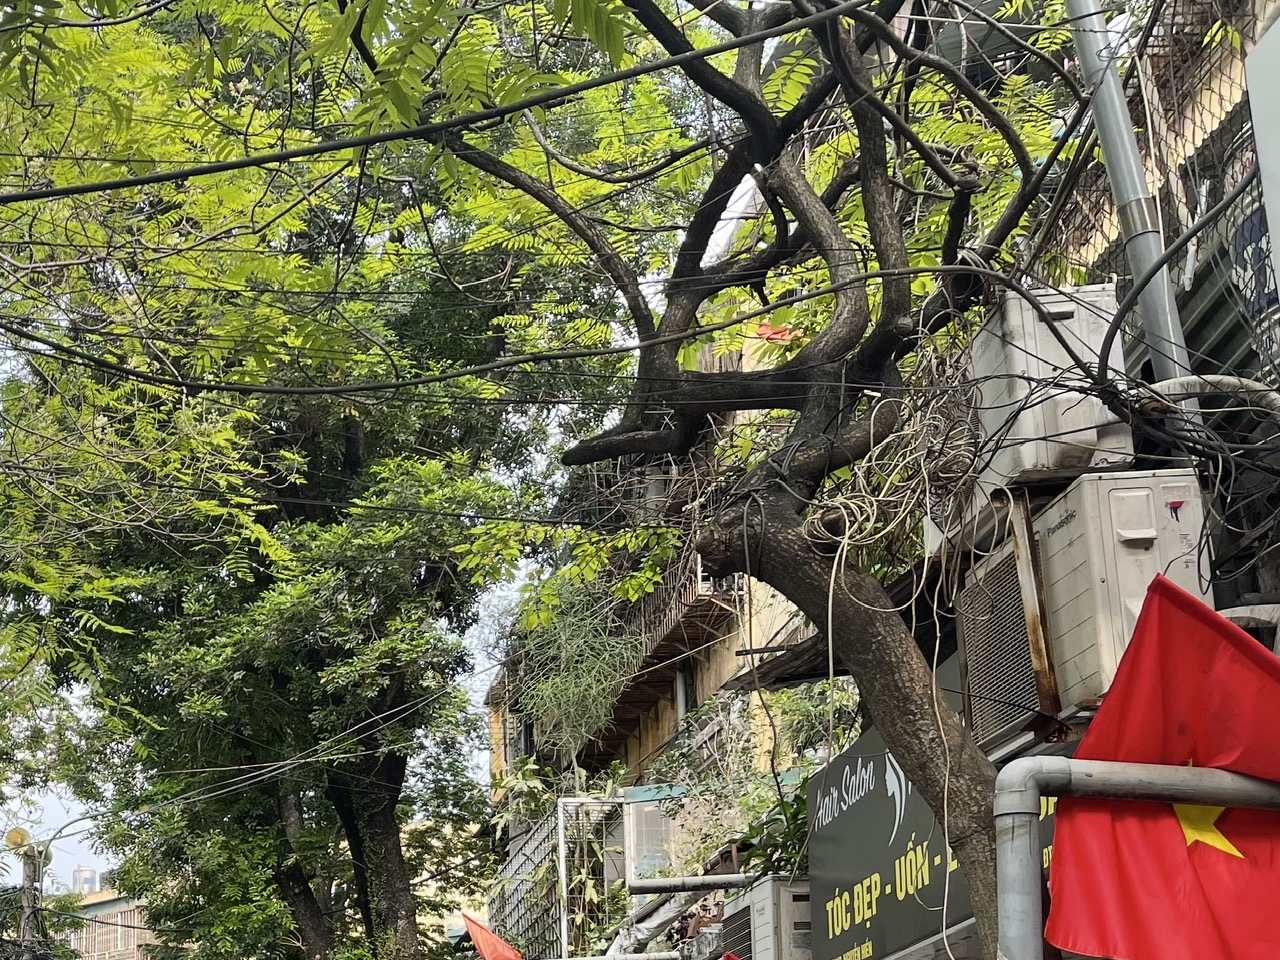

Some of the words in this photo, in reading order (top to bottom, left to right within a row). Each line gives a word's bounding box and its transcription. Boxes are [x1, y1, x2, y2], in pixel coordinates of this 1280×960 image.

[1047, 508, 1077, 538] Panasonic
[814, 785, 840, 832] Hair
[841, 755, 876, 812] Salon
[826, 887, 851, 940] TÓC
[853, 872, 881, 929] ĐẸP
[894, 832, 930, 901] UỐN
